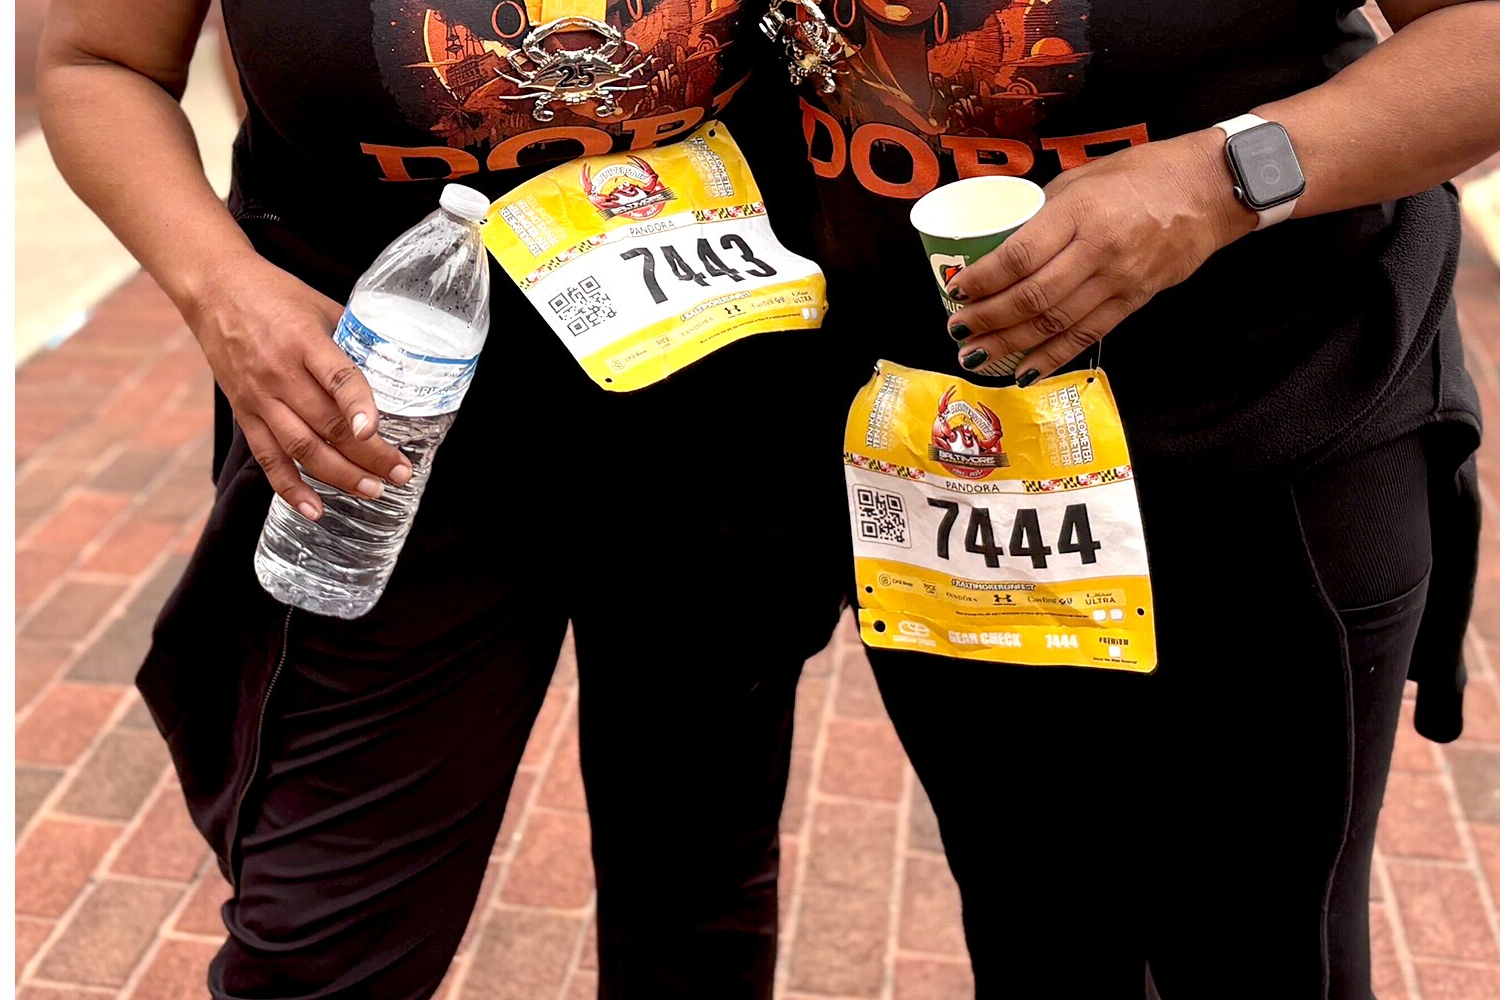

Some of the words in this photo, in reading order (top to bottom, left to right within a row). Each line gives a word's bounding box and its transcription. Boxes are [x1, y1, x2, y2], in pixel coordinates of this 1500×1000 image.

[555, 63, 596, 89] 25
[360, 70, 754, 182] DOP
[630, 220, 675, 235] PANDORA
[620, 234, 777, 305] 7443
[945, 480, 999, 493] PANDORA
[926, 497, 1101, 568] 7444
[1085, 597, 1116, 605] ULTRA
[980, 631, 1022, 647] CHECK
[1045, 634, 1079, 649] 7444
